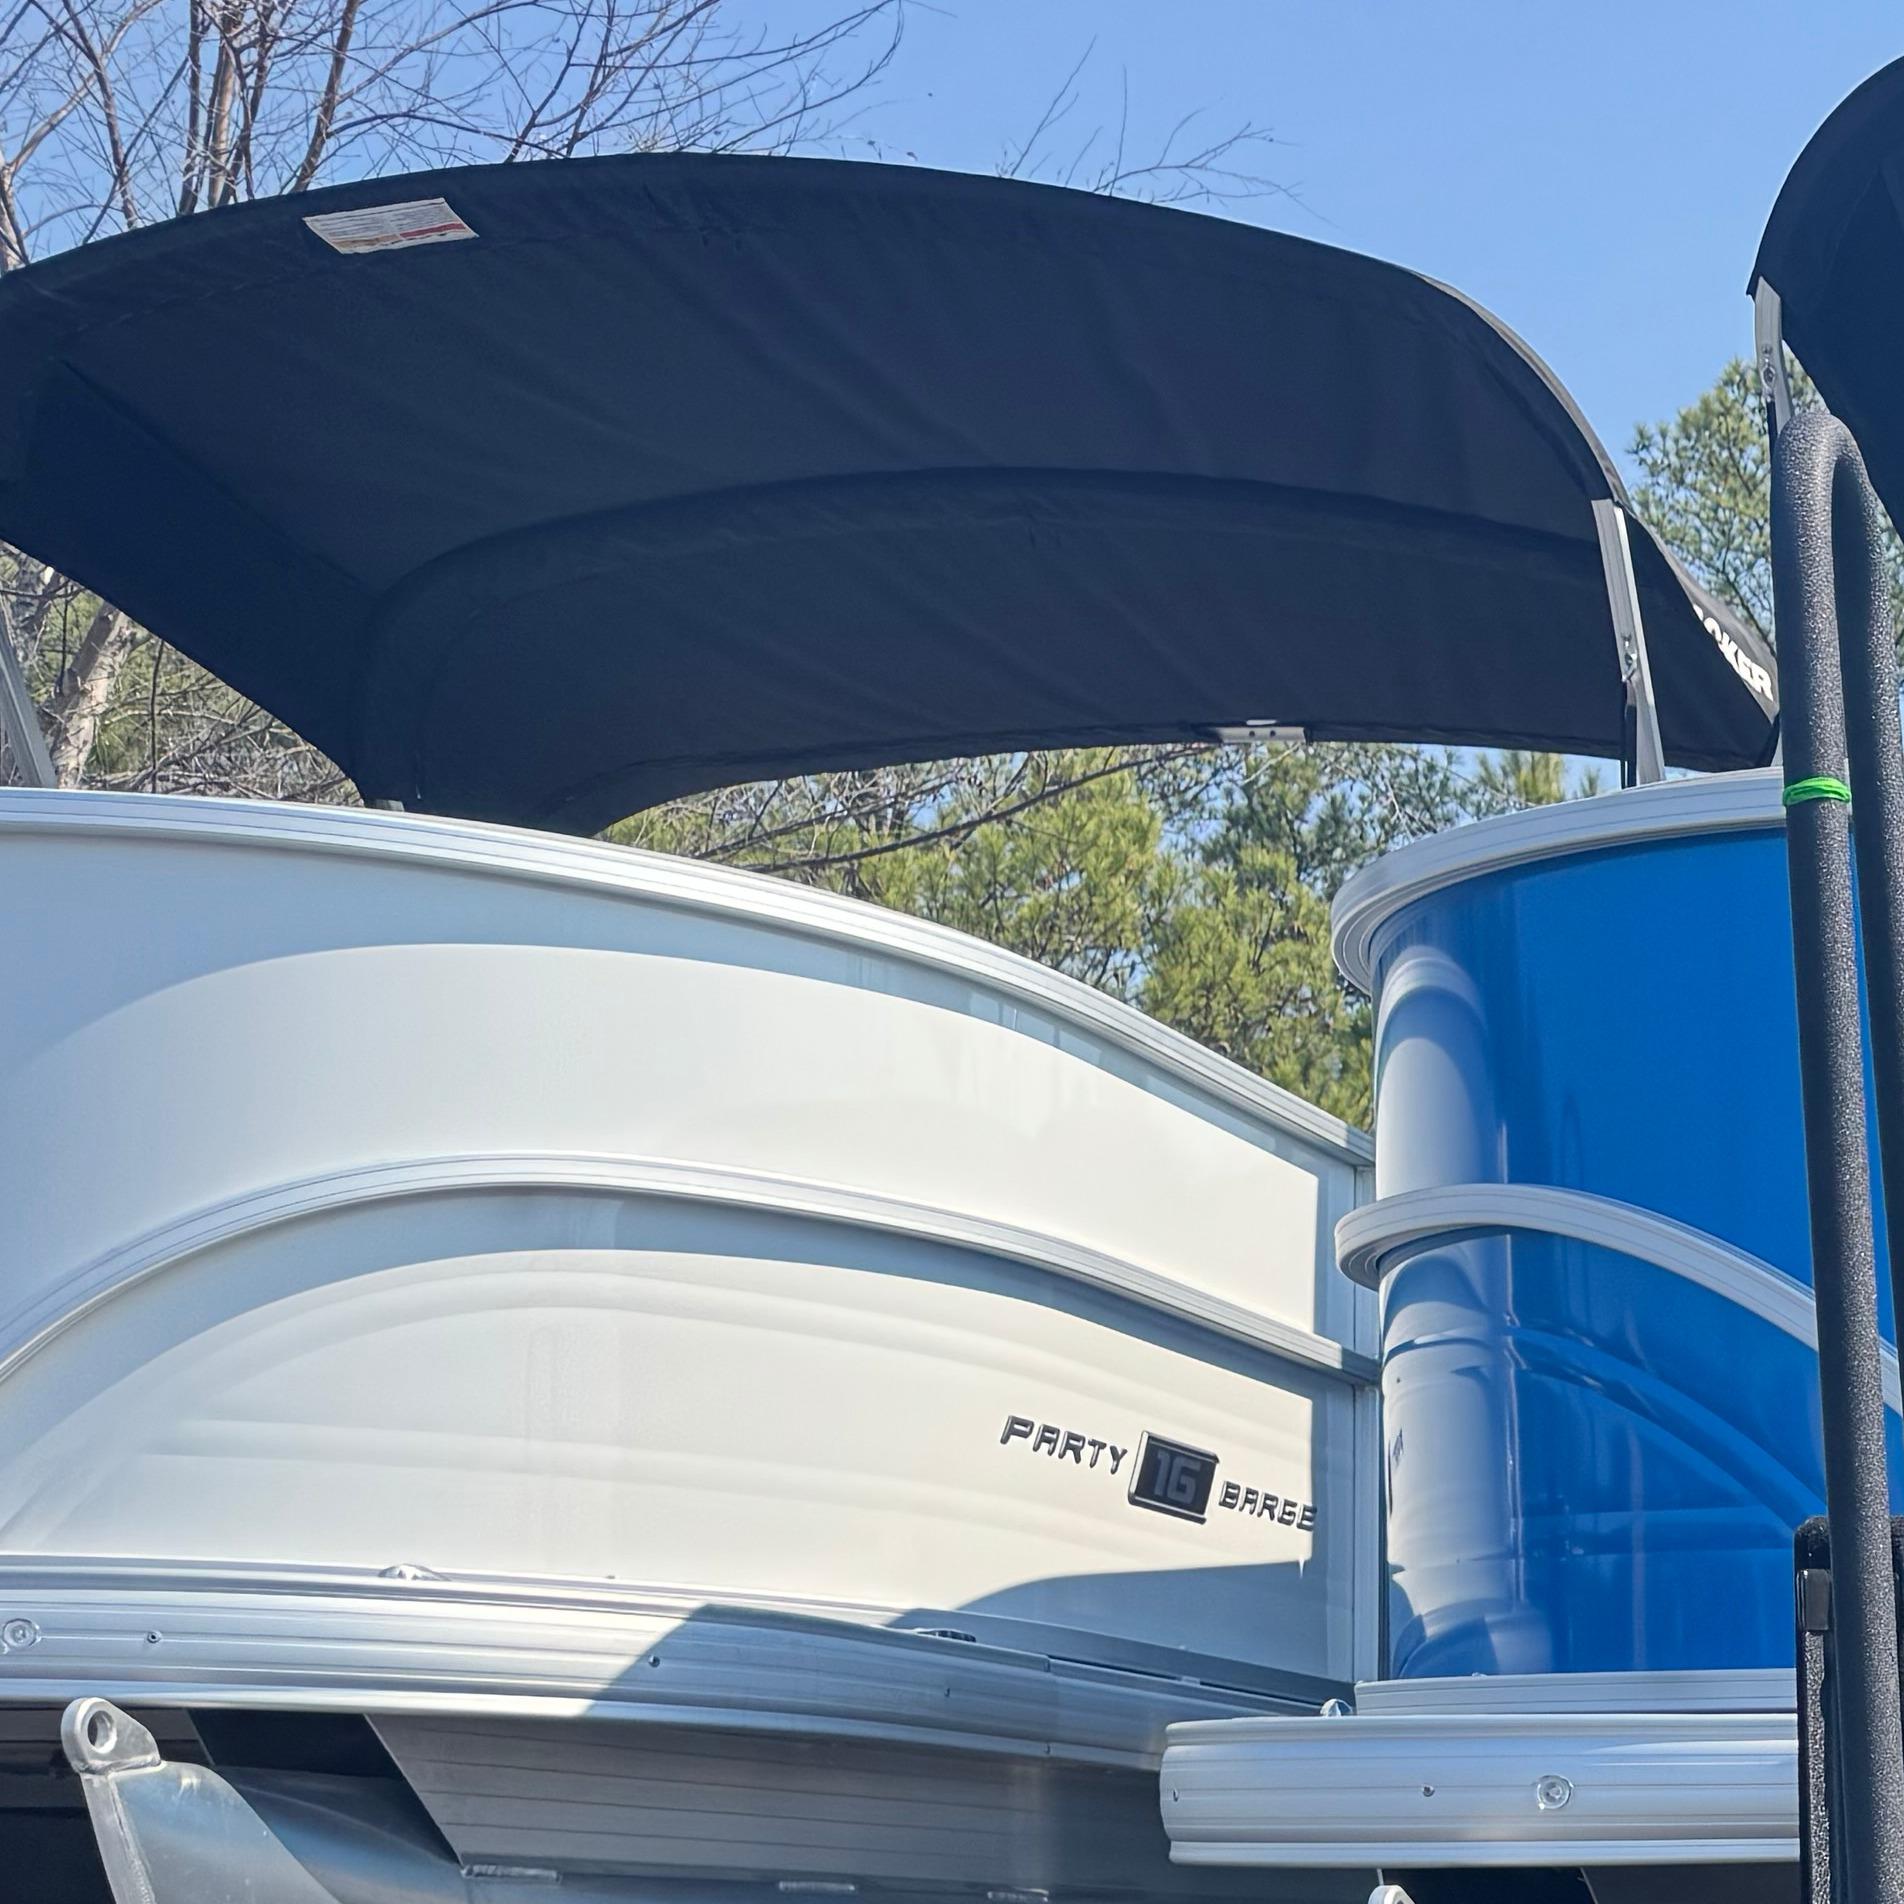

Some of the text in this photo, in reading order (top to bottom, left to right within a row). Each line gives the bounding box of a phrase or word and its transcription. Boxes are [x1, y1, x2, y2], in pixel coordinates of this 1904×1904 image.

[1693, 604, 1774, 701] CKER
[1000, 1415, 1318, 1532] PARTY 16 BARGE
